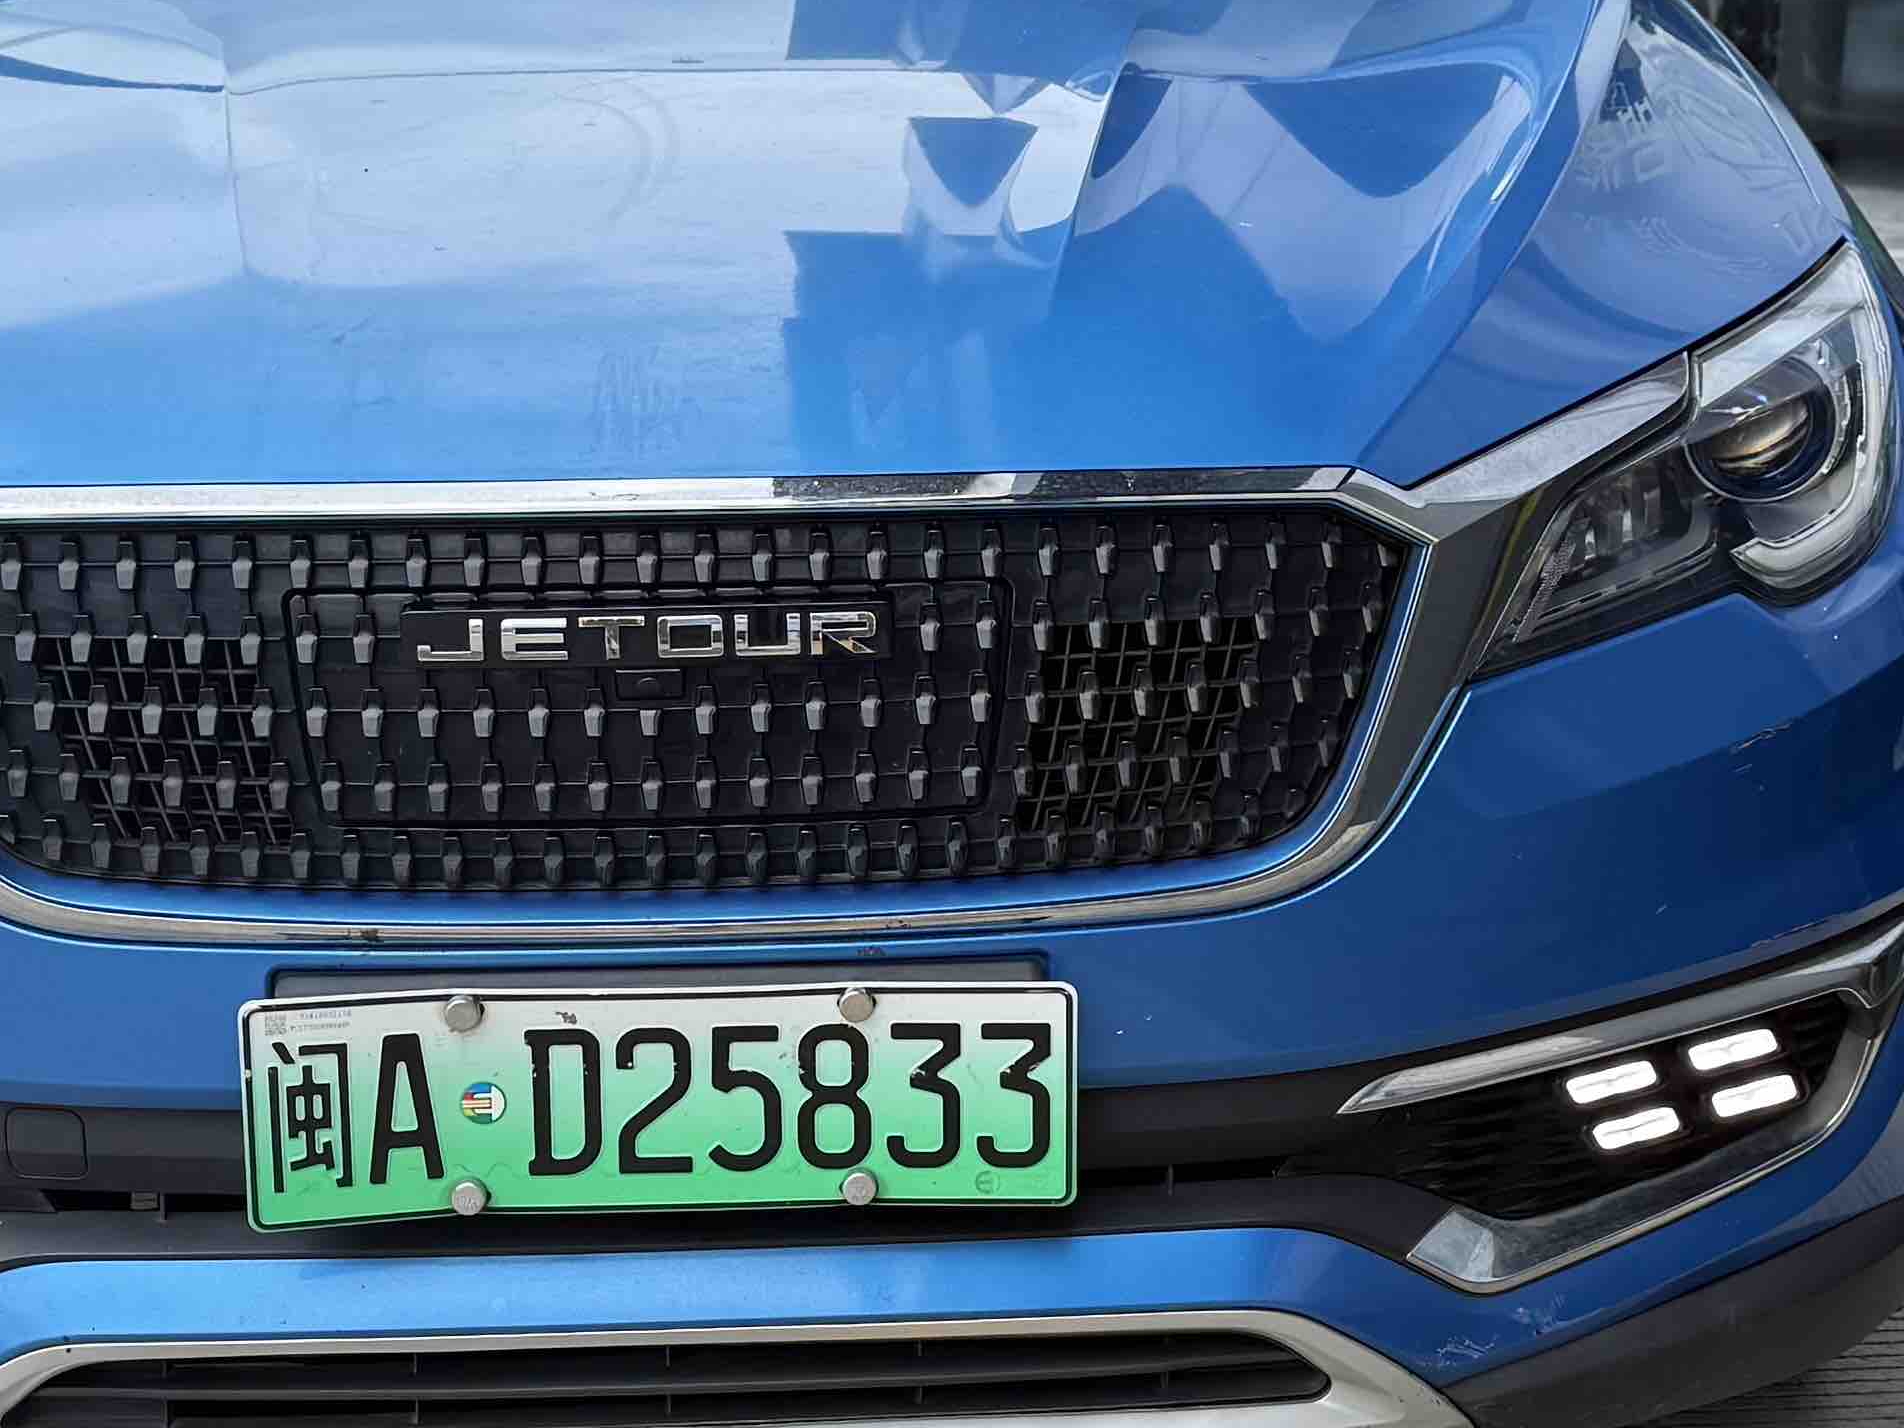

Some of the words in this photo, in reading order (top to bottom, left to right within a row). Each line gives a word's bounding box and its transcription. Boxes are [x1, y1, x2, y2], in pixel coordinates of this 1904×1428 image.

[415, 610, 878, 663] JETOUR
[266, 1032, 445, 1194] 闽A
[525, 1022, 1054, 1179] D25833
